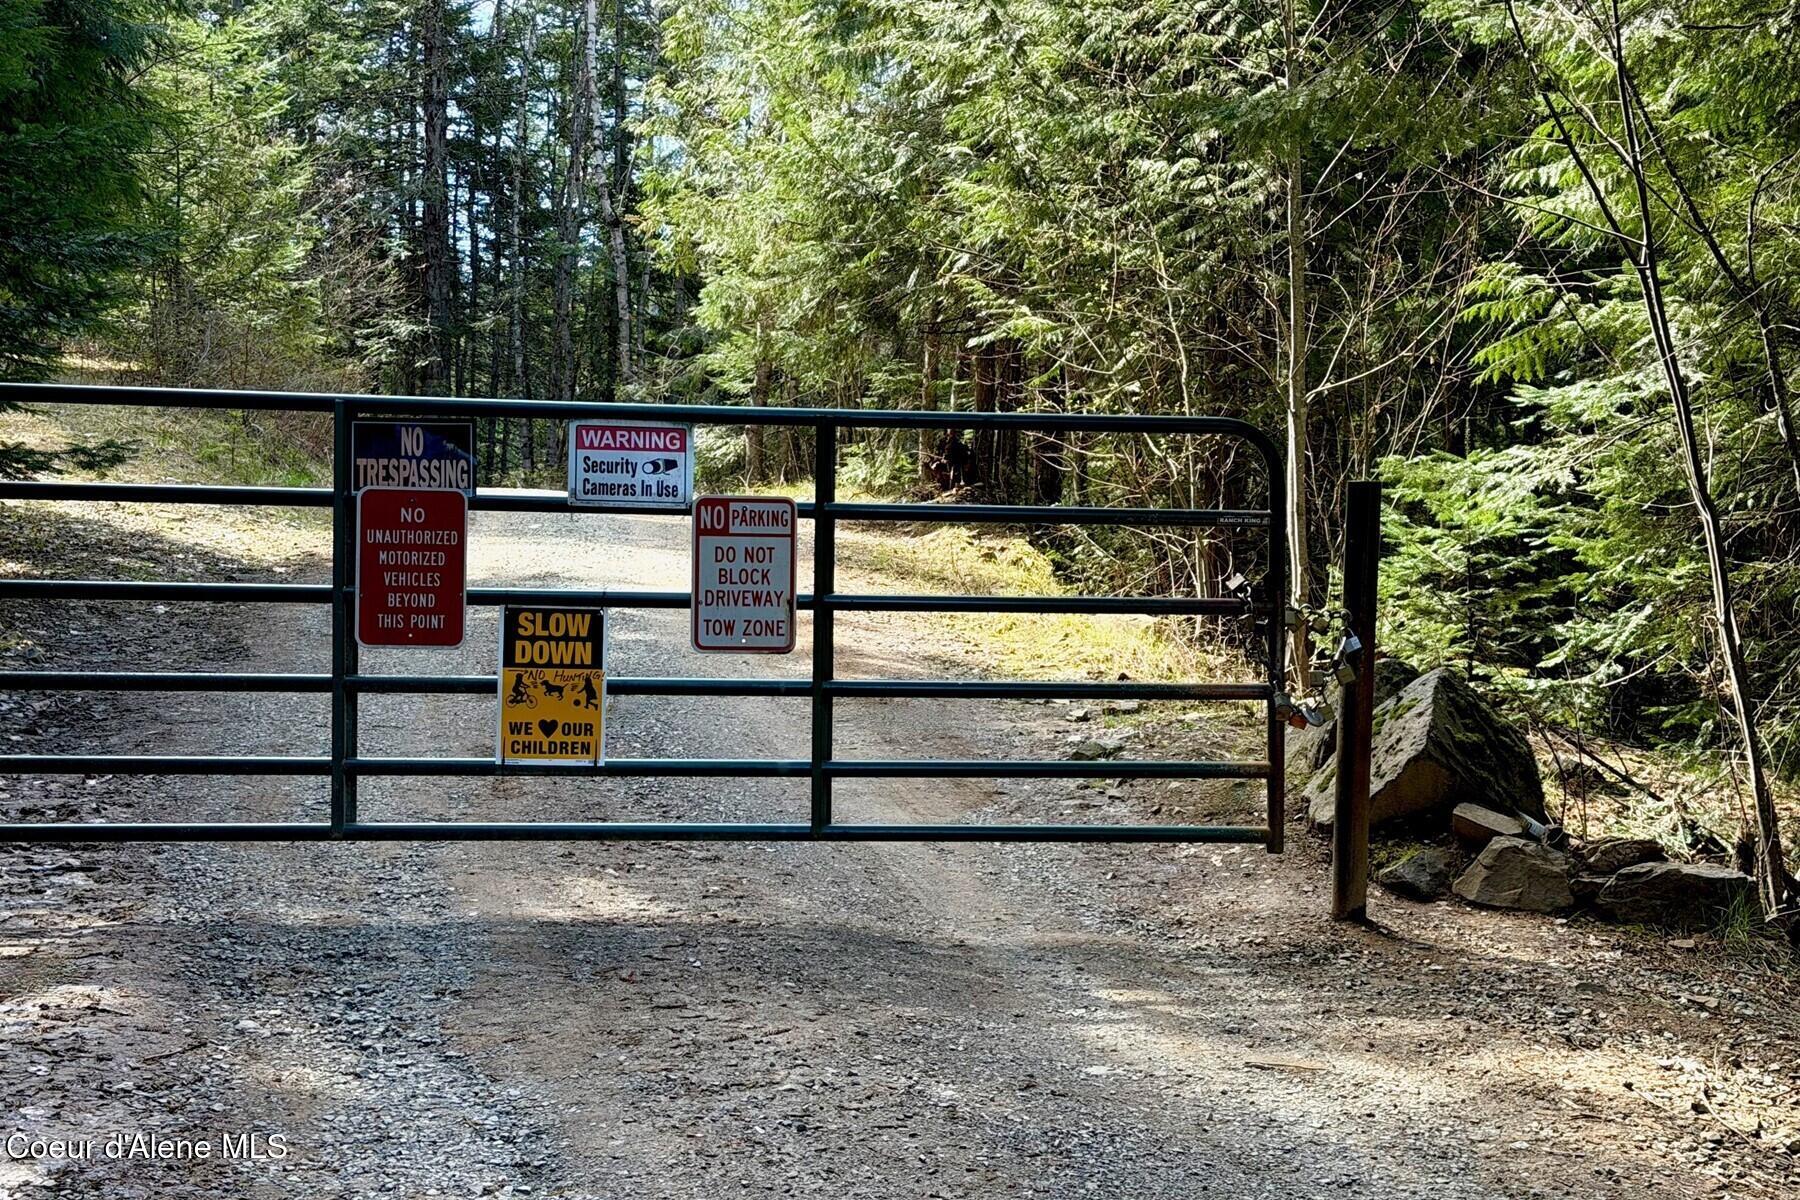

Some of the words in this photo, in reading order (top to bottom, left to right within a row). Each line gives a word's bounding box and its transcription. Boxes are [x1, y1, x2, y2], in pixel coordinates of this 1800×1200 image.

[401, 426, 424, 457] NO
[582, 430, 680, 450] WARNING
[356, 458, 469, 489] TRESPASSING
[583, 456, 638, 478] Security
[583, 478, 637, 497] Cameras
[641, 480, 653, 497] In
[657, 480, 679, 498] Use
[400, 507, 425, 523] NO
[700, 505, 725, 530] NO
[731, 509, 789, 528] PARKING
[366, 529, 459, 545] UNAUTHORIZED
[379, 551, 446, 566] MOTORIZED
[714, 546, 736, 563] DO
[744, 546, 775, 564] NOT
[384, 571, 441, 587] VEHICLES
[718, 568, 770, 586] BLOCK
[387, 593, 436, 607] BEYOND
[704, 590, 784, 608] DRIVEWAY
[378, 614, 404, 629] THIS
[410, 614, 446, 629] POINT
[518, 612, 591, 637] SLOW
[703, 619, 736, 637] TOW
[742, 619, 785, 637] ZONE
[514, 640, 592, 665] DOWN
[527, 669, 546, 681] NO
[508, 721, 533, 736] WE
[561, 722, 594, 737] OUR
[510, 740, 591, 755] CHILDREN
